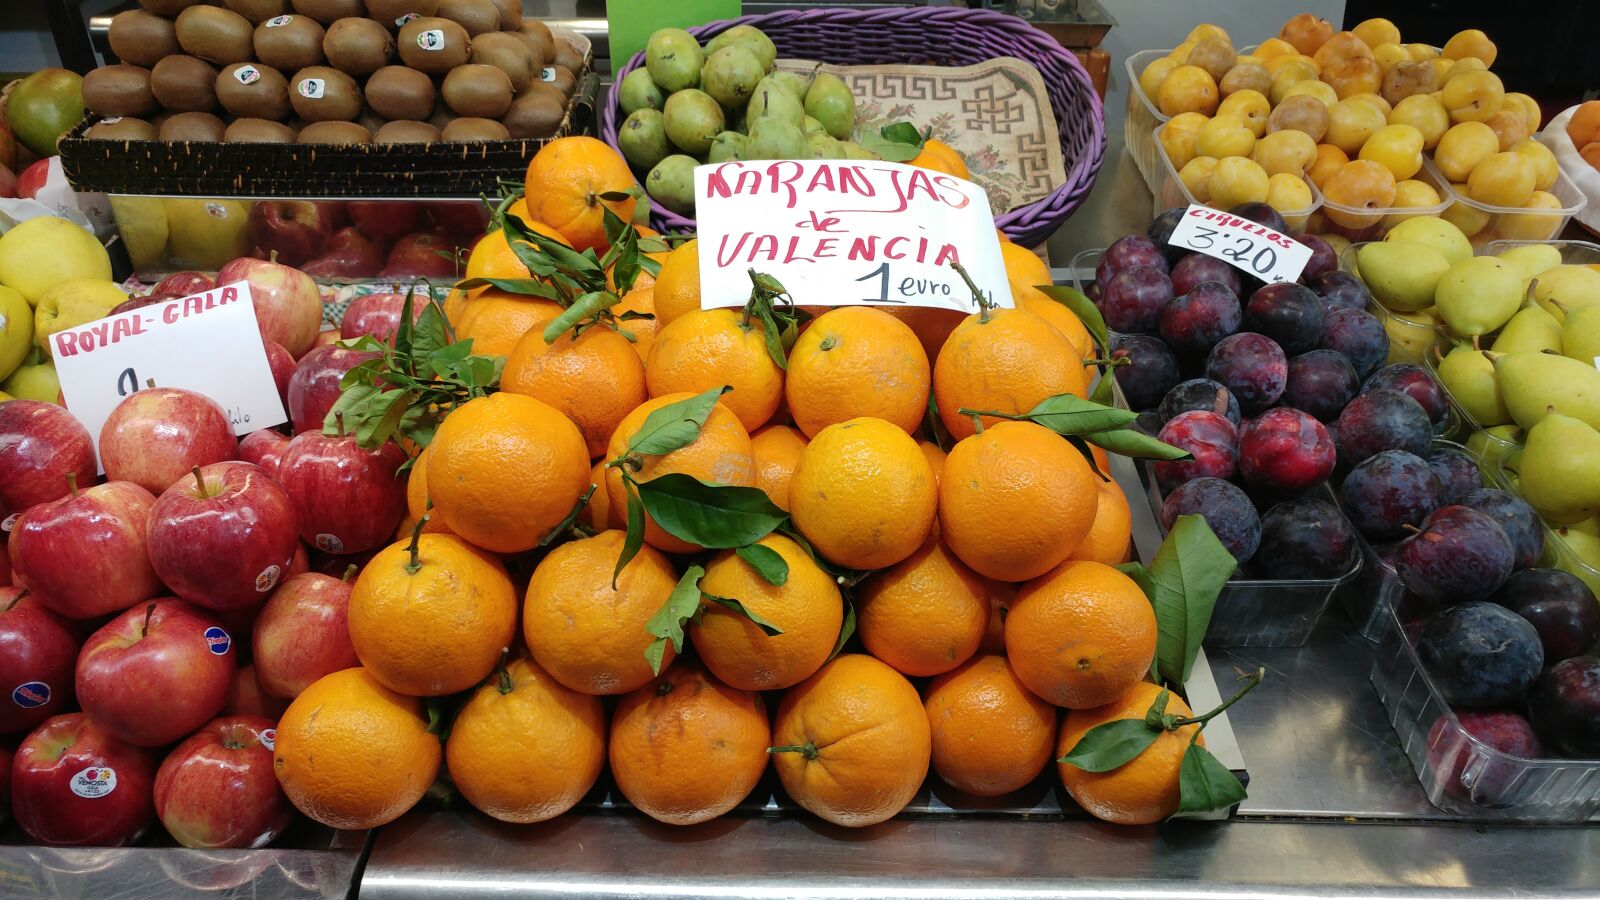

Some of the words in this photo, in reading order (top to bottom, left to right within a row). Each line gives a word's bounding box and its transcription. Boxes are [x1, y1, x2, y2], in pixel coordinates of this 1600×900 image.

[706, 160, 970, 213] NARANJAS
[795, 210, 849, 233] de
[1188, 209, 1294, 249] CIRUELOS
[716, 226, 961, 268] VALENCIA
[855, 262, 907, 303] 1
[897, 277, 952, 297] euro
